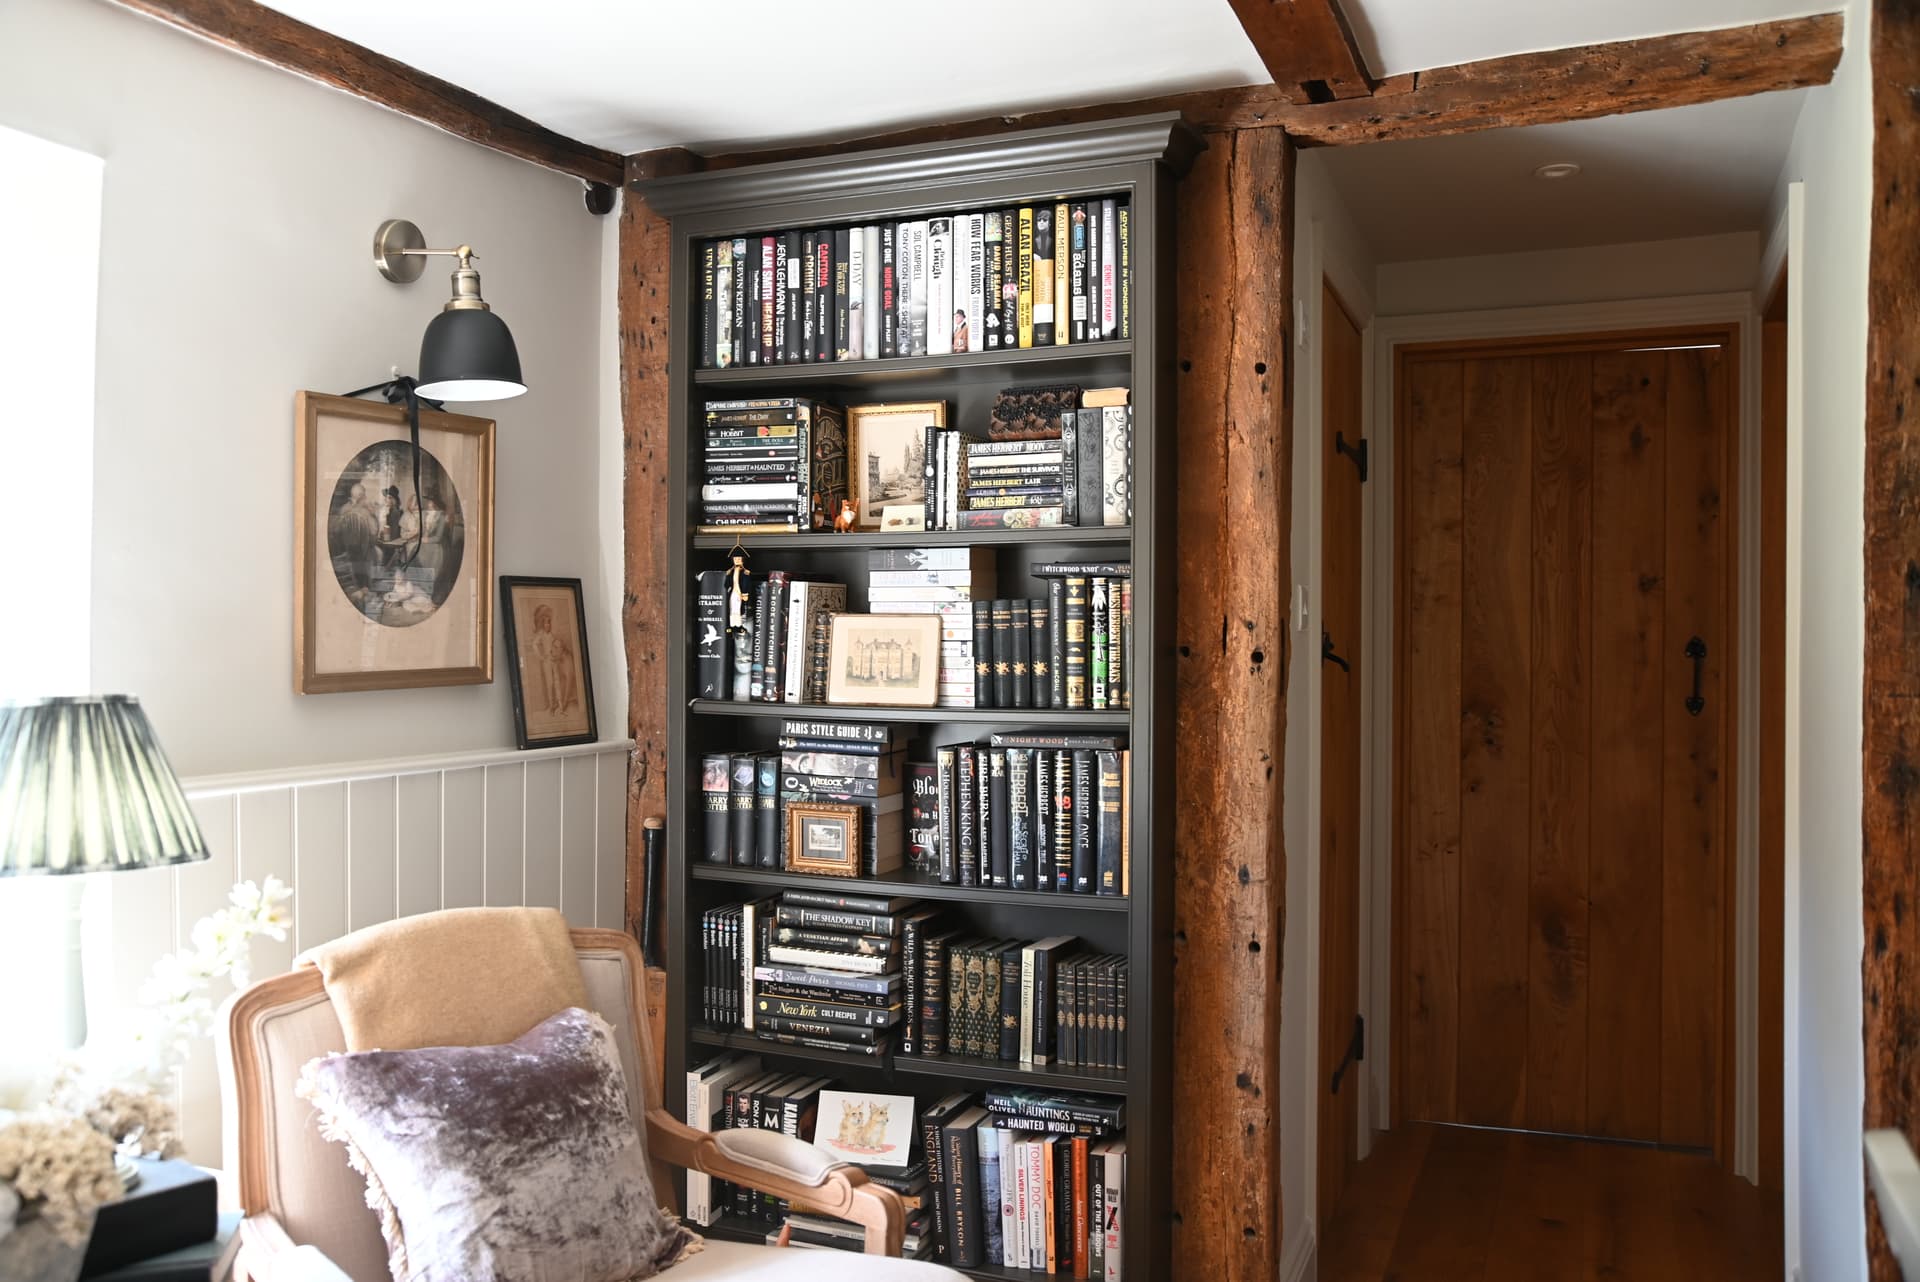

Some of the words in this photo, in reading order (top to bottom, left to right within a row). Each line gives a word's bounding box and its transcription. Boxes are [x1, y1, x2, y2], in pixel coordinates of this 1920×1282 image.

[971, 218, 981, 240] HOW
[1005, 215, 1013, 244] GEOFF
[1020, 218, 1031, 250] ALAN
[1057, 209, 1065, 235] PAUL
[884, 229, 892, 247] JUST
[901, 228, 909, 250] TONY
[913, 230, 922, 244] SOL
[1121, 210, 1129, 266] ADVENTURES
[762, 245, 773, 269] ALAN
[777, 243, 786, 267] JENS
[884, 248, 892, 264] ONE
[913, 245, 922, 281] CAMPBELL
[932, 239, 942, 280] Clough
[971, 241, 981, 262] FEAR
[993, 246, 1002, 272] DAVID
[1005, 245, 1013, 277] HURST
[1057, 238, 1065, 280] MERSON
[736, 260, 744, 289] KEVIN
[803, 255, 814, 294] CROUCH
[820, 243, 829, 288] CANTONA
[852, 251, 862, 286] D-DAY
[884, 266, 892, 288] MORE
[901, 251, 909, 280] COTON
[1020, 253, 1031, 296] BRAZIL
[1072, 253, 1084, 295] adams
[1104, 264, 1112, 287] DENNIS
[1121, 268, 1129, 277] IN
[762, 270, 773, 300] SMITH
[776, 268, 786, 315] LEHMANN
[971, 264, 981, 295] WORKS
[993, 273, 1002, 310] SEAMAN
[884, 289, 892, 310] GOAL
[901, 282, 909, 305] THERE
[1104, 288, 1112, 322] BERGKAMP
[762, 302, 773, 332] HEADS
[1121, 279, 1129, 338] WONDERLAND
[762, 333, 773, 347] UP
[720, 430, 745, 438] HOBBIT
[970, 444, 991, 454] JAMES
[992, 443, 1023, 453] HERBERT
[1024, 442, 1045, 451] MOON
[707, 464, 725, 472] JAMES
[725, 463, 750, 472] HERBERT
[754, 463, 785, 471] HAUNTED
[1032, 465, 1060, 473] SURVIVOR
[993, 478, 1024, 486] HERBERT
[971, 497, 995, 508] JAMES
[995, 496, 1027, 506] HERBERT
[1081, 565, 1099, 574] KNOT
[1109, 583, 1121, 609] JAMES
[1109, 609, 1121, 646] HERBERT
[753, 630, 762, 663] WOODS
[767, 624, 775, 666] WITCHING
[1109, 646, 1121, 663] THE
[1109, 663, 1121, 683] RATS
[786, 722, 809, 735] PARIS
[810, 723, 834, 737] STYLE
[836, 725, 861, 739] GUIDE
[1010, 736, 1038, 744] NIGHT
[1039, 737, 1063, 745] WOOD
[809, 777, 843, 787] WEDLOCK
[960, 751, 972, 810] STEPHEN
[1040, 760, 1049, 785] JAMES
[1055, 756, 1071, 793] JAMES
[1078, 760, 1090, 785] JAMES
[979, 785, 989, 820] BURN
[1011, 763, 1028, 817] HERBERT
[1040, 785, 1049, 816] HERBERT
[1078, 786, 1090, 819] HERBERT
[960, 811, 972, 846] KING
[1055, 812, 1071, 869] HERBERT
[1078, 823, 1090, 849] ONCE
[805, 912, 820, 922] THE
[821, 913, 855, 925] SHADOW
[855, 917, 872, 928] KEY
[803, 933, 830, 941] VENETIAN
[785, 972, 807, 983] Sweet
[808, 974, 831, 985] Paris
[1023, 979, 1033, 1008] House
[777, 1001, 798, 1015] New
[798, 1003, 818, 1018] York
[820, 1008, 834, 1017] CULT
[835, 1010, 857, 1020] RECIPES
[789, 1022, 832, 1036] VENEZIA
[988, 1104, 1017, 1114] OLIVER
[993, 1098, 1011, 1107] NEIL
[1018, 1102, 1070, 1121] HAUNTINGS
[1007, 1118, 1044, 1131] HAUNTED
[1048, 1121, 1076, 1134] WORLD
[925, 1125, 938, 1183] ENGLAND
[1031, 1144, 1041, 1185] TOMMY
[1063, 1149, 1071, 1179] GEORGE
[1017, 1168, 1026, 1193] SILVER
[1094, 1183, 1102, 1199] OUT
[955, 1188, 963, 1207] BILL
[1017, 1193, 1026, 1221] LININGS
[1031, 1186, 1042, 1210] DOC
[1063, 1179, 1071, 1212] GRAHAM
[1095, 1199, 1102, 1211] OF
[955, 1210, 965, 1247] BRYSON
[1095, 1224, 1103, 1257] SHADOWS
